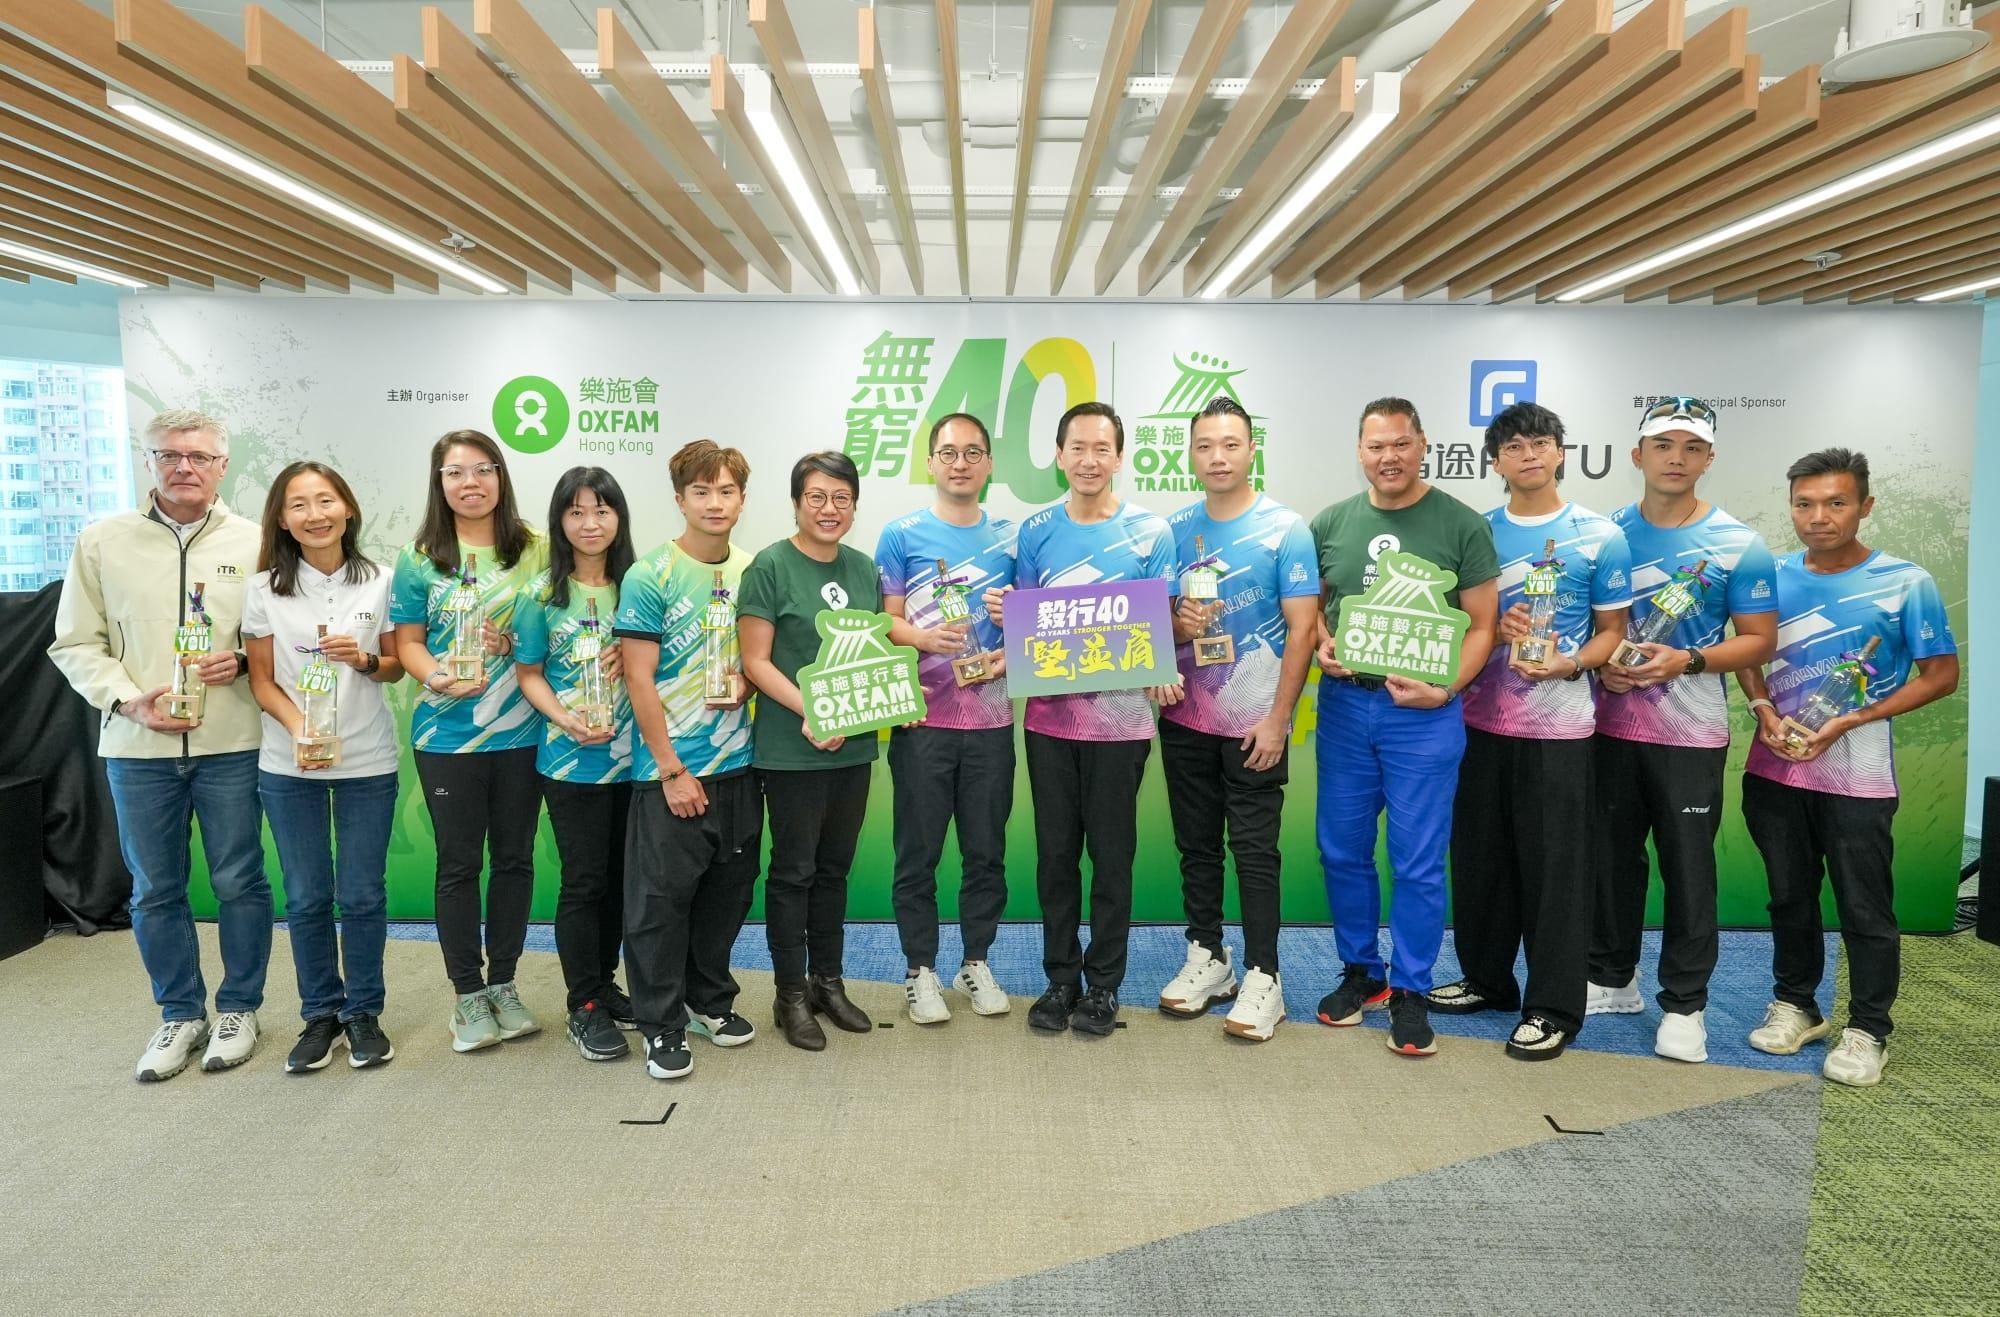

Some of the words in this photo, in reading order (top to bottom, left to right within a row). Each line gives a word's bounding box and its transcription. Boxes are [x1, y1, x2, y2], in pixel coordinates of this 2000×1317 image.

[387, 389, 412, 402] 主辦
[416, 390, 470, 403] Organiser
[579, 376, 660, 404] 樂施會
[1699, 396, 1738, 409] incipal
[1740, 396, 1787, 409] Sponsor
[577, 410, 659, 433] OXFAM
[1135, 425, 1267, 446] 樂施者
[579, 438, 615, 455] Hong
[618, 438, 653, 455] Kong
[1133, 447, 1265, 476] OXM
[1028, 510, 1054, 530] AKIV
[1527, 580, 1555, 593] YOU
[1528, 573, 1554, 582] THANK
[449, 597, 476, 609] YOU
[1657, 590, 1686, 615] YOU
[1666, 583, 1692, 605] THANK
[707, 603, 731, 614] THANK
[943, 602, 969, 619] YOU
[1036, 594, 1130, 630] 毅行40
[705, 613, 729, 627] YOU
[1048, 629, 1070, 637] YEARS
[1073, 625, 1112, 635] STRONGER
[1113, 622, 1151, 632] TOGETHER
[1347, 611, 1456, 641] 樂施毅行者
[179, 627, 209, 636] THANK
[178, 635, 209, 651] YOU
[1344, 628, 1451, 663] OXFAM
[1343, 648, 1449, 676] TRAILWALKER
[304, 665, 334, 679] THANK
[809, 662, 910, 697] 樂施毅行者
[302, 673, 332, 692] YOU
[813, 680, 915, 719] OXFAM
[818, 700, 918, 732] TRAILWALKER
